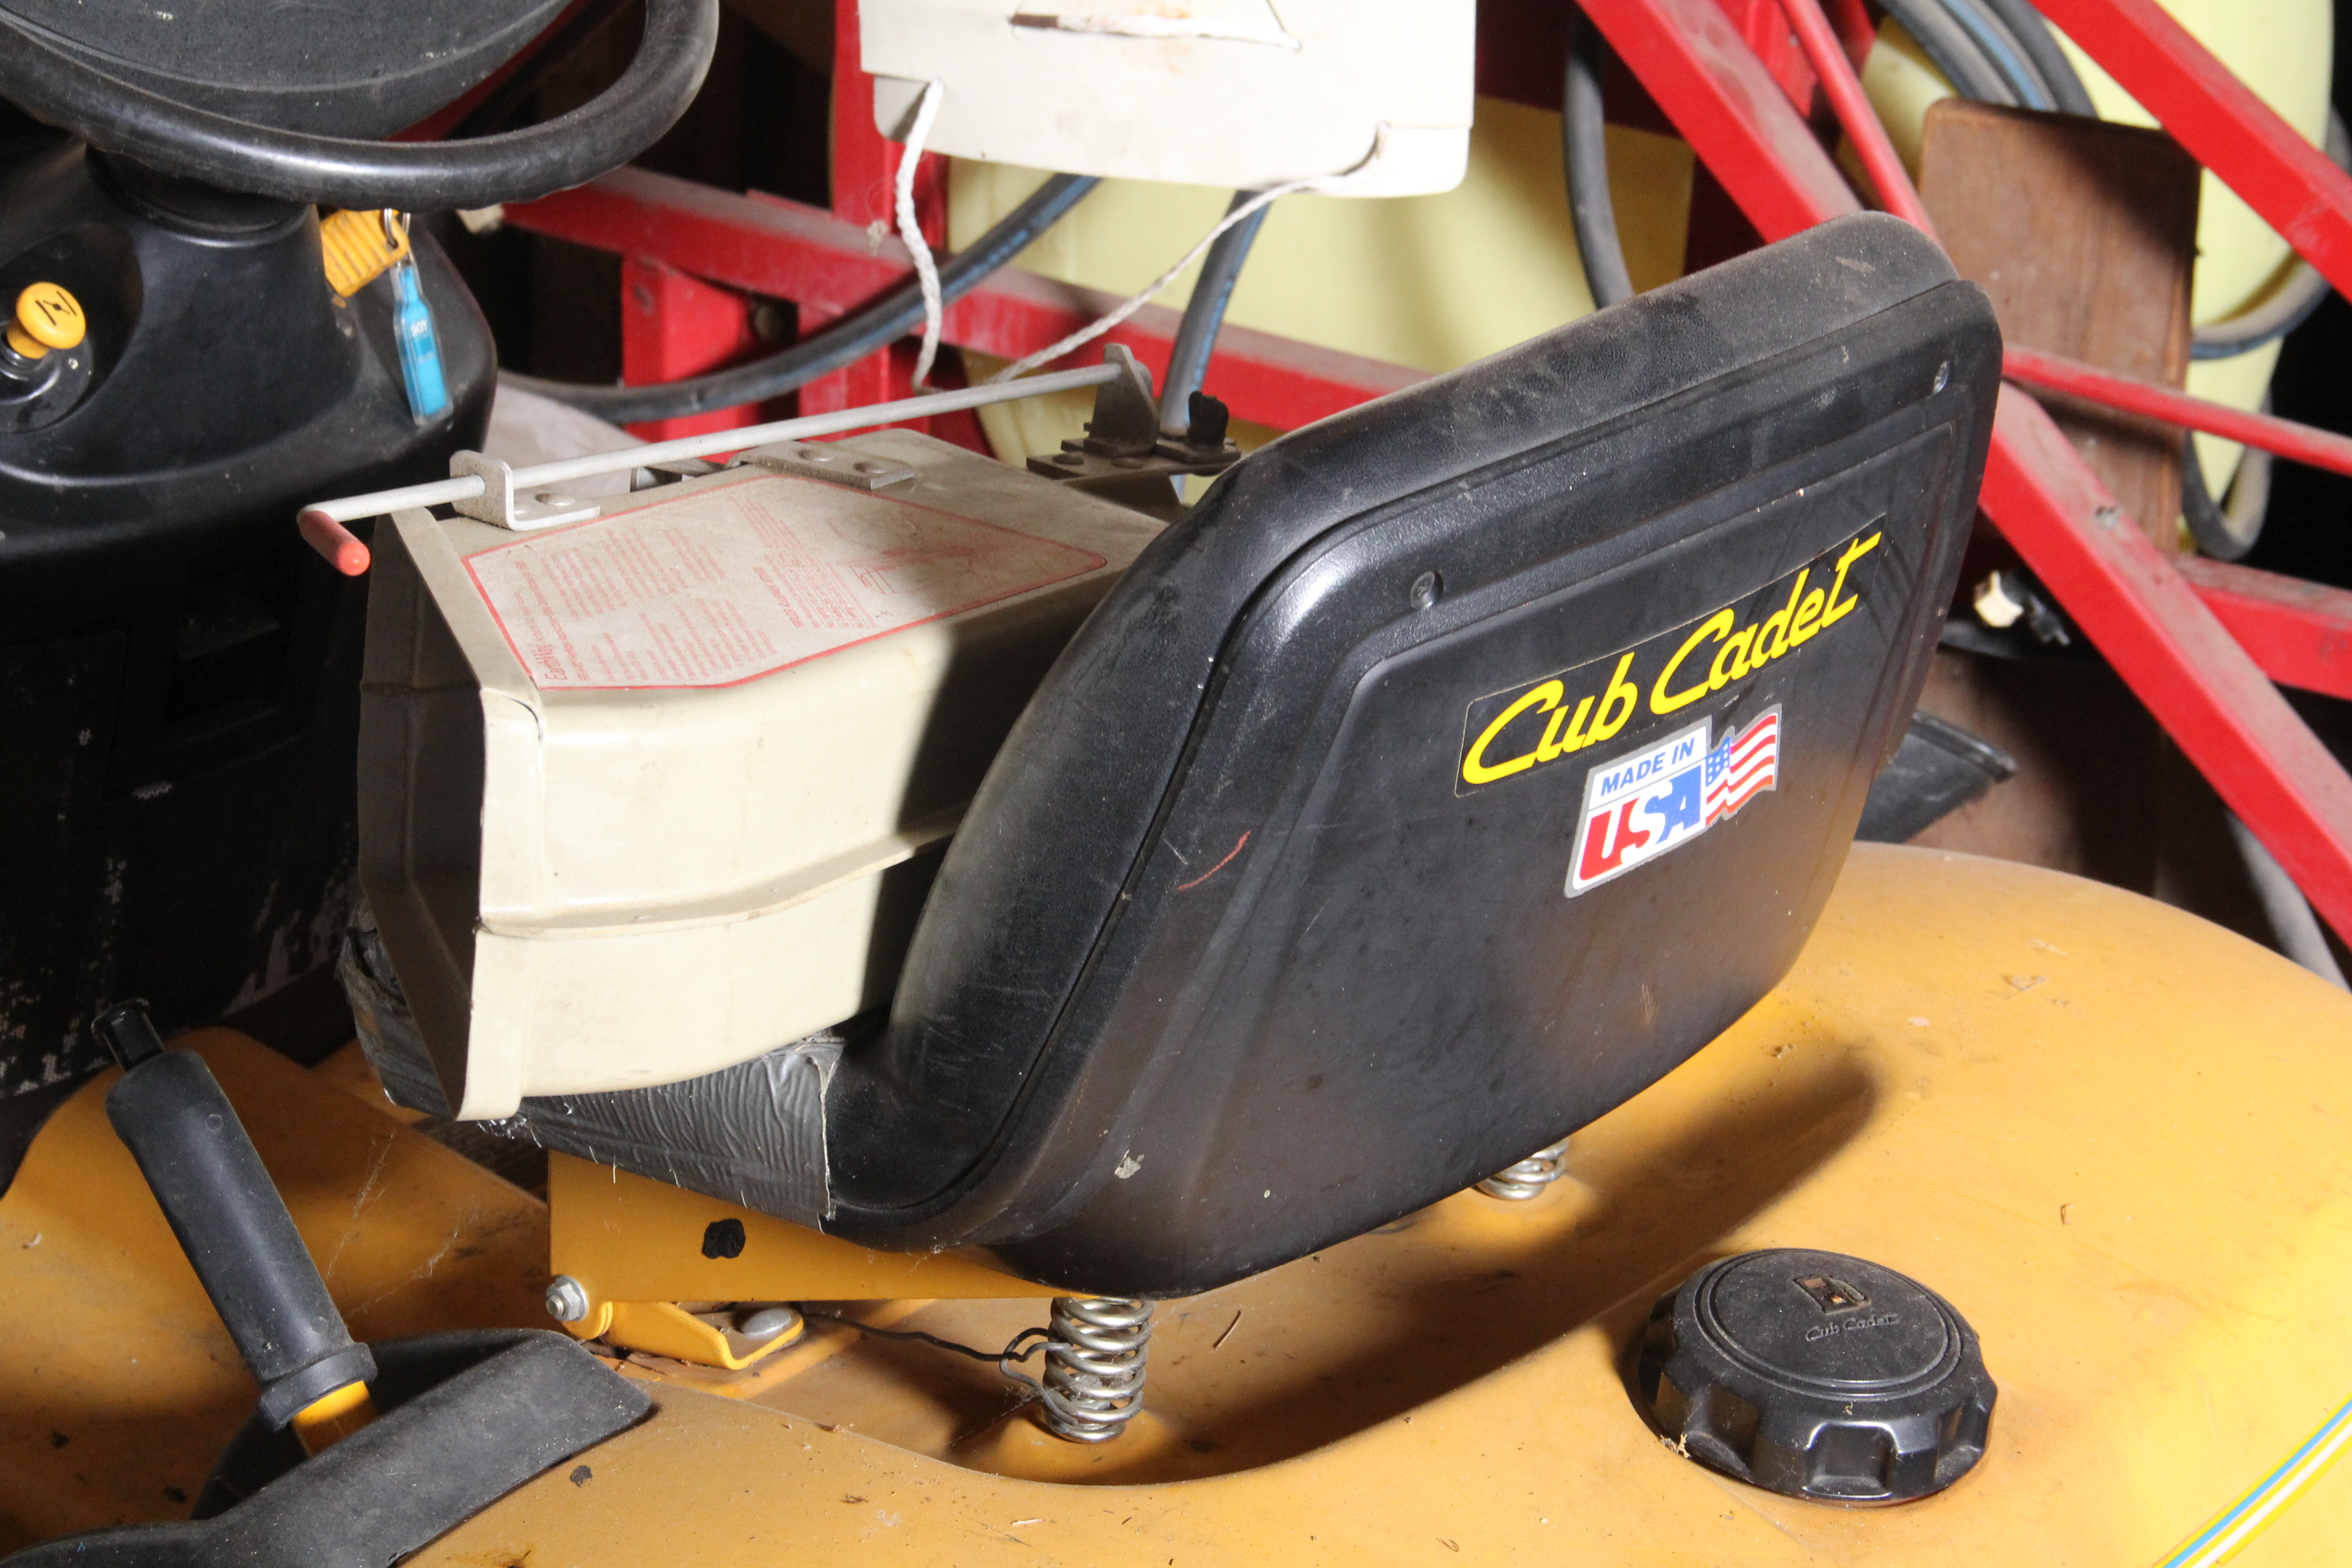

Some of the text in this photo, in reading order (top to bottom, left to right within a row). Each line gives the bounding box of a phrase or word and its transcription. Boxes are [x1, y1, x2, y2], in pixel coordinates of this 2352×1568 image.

[1463, 531, 1882, 784] Cub Cadet
[1600, 737, 1695, 797] MADE IN
[1579, 764, 1701, 881] USA
[1805, 1313, 1901, 1342] Cub Cadet
